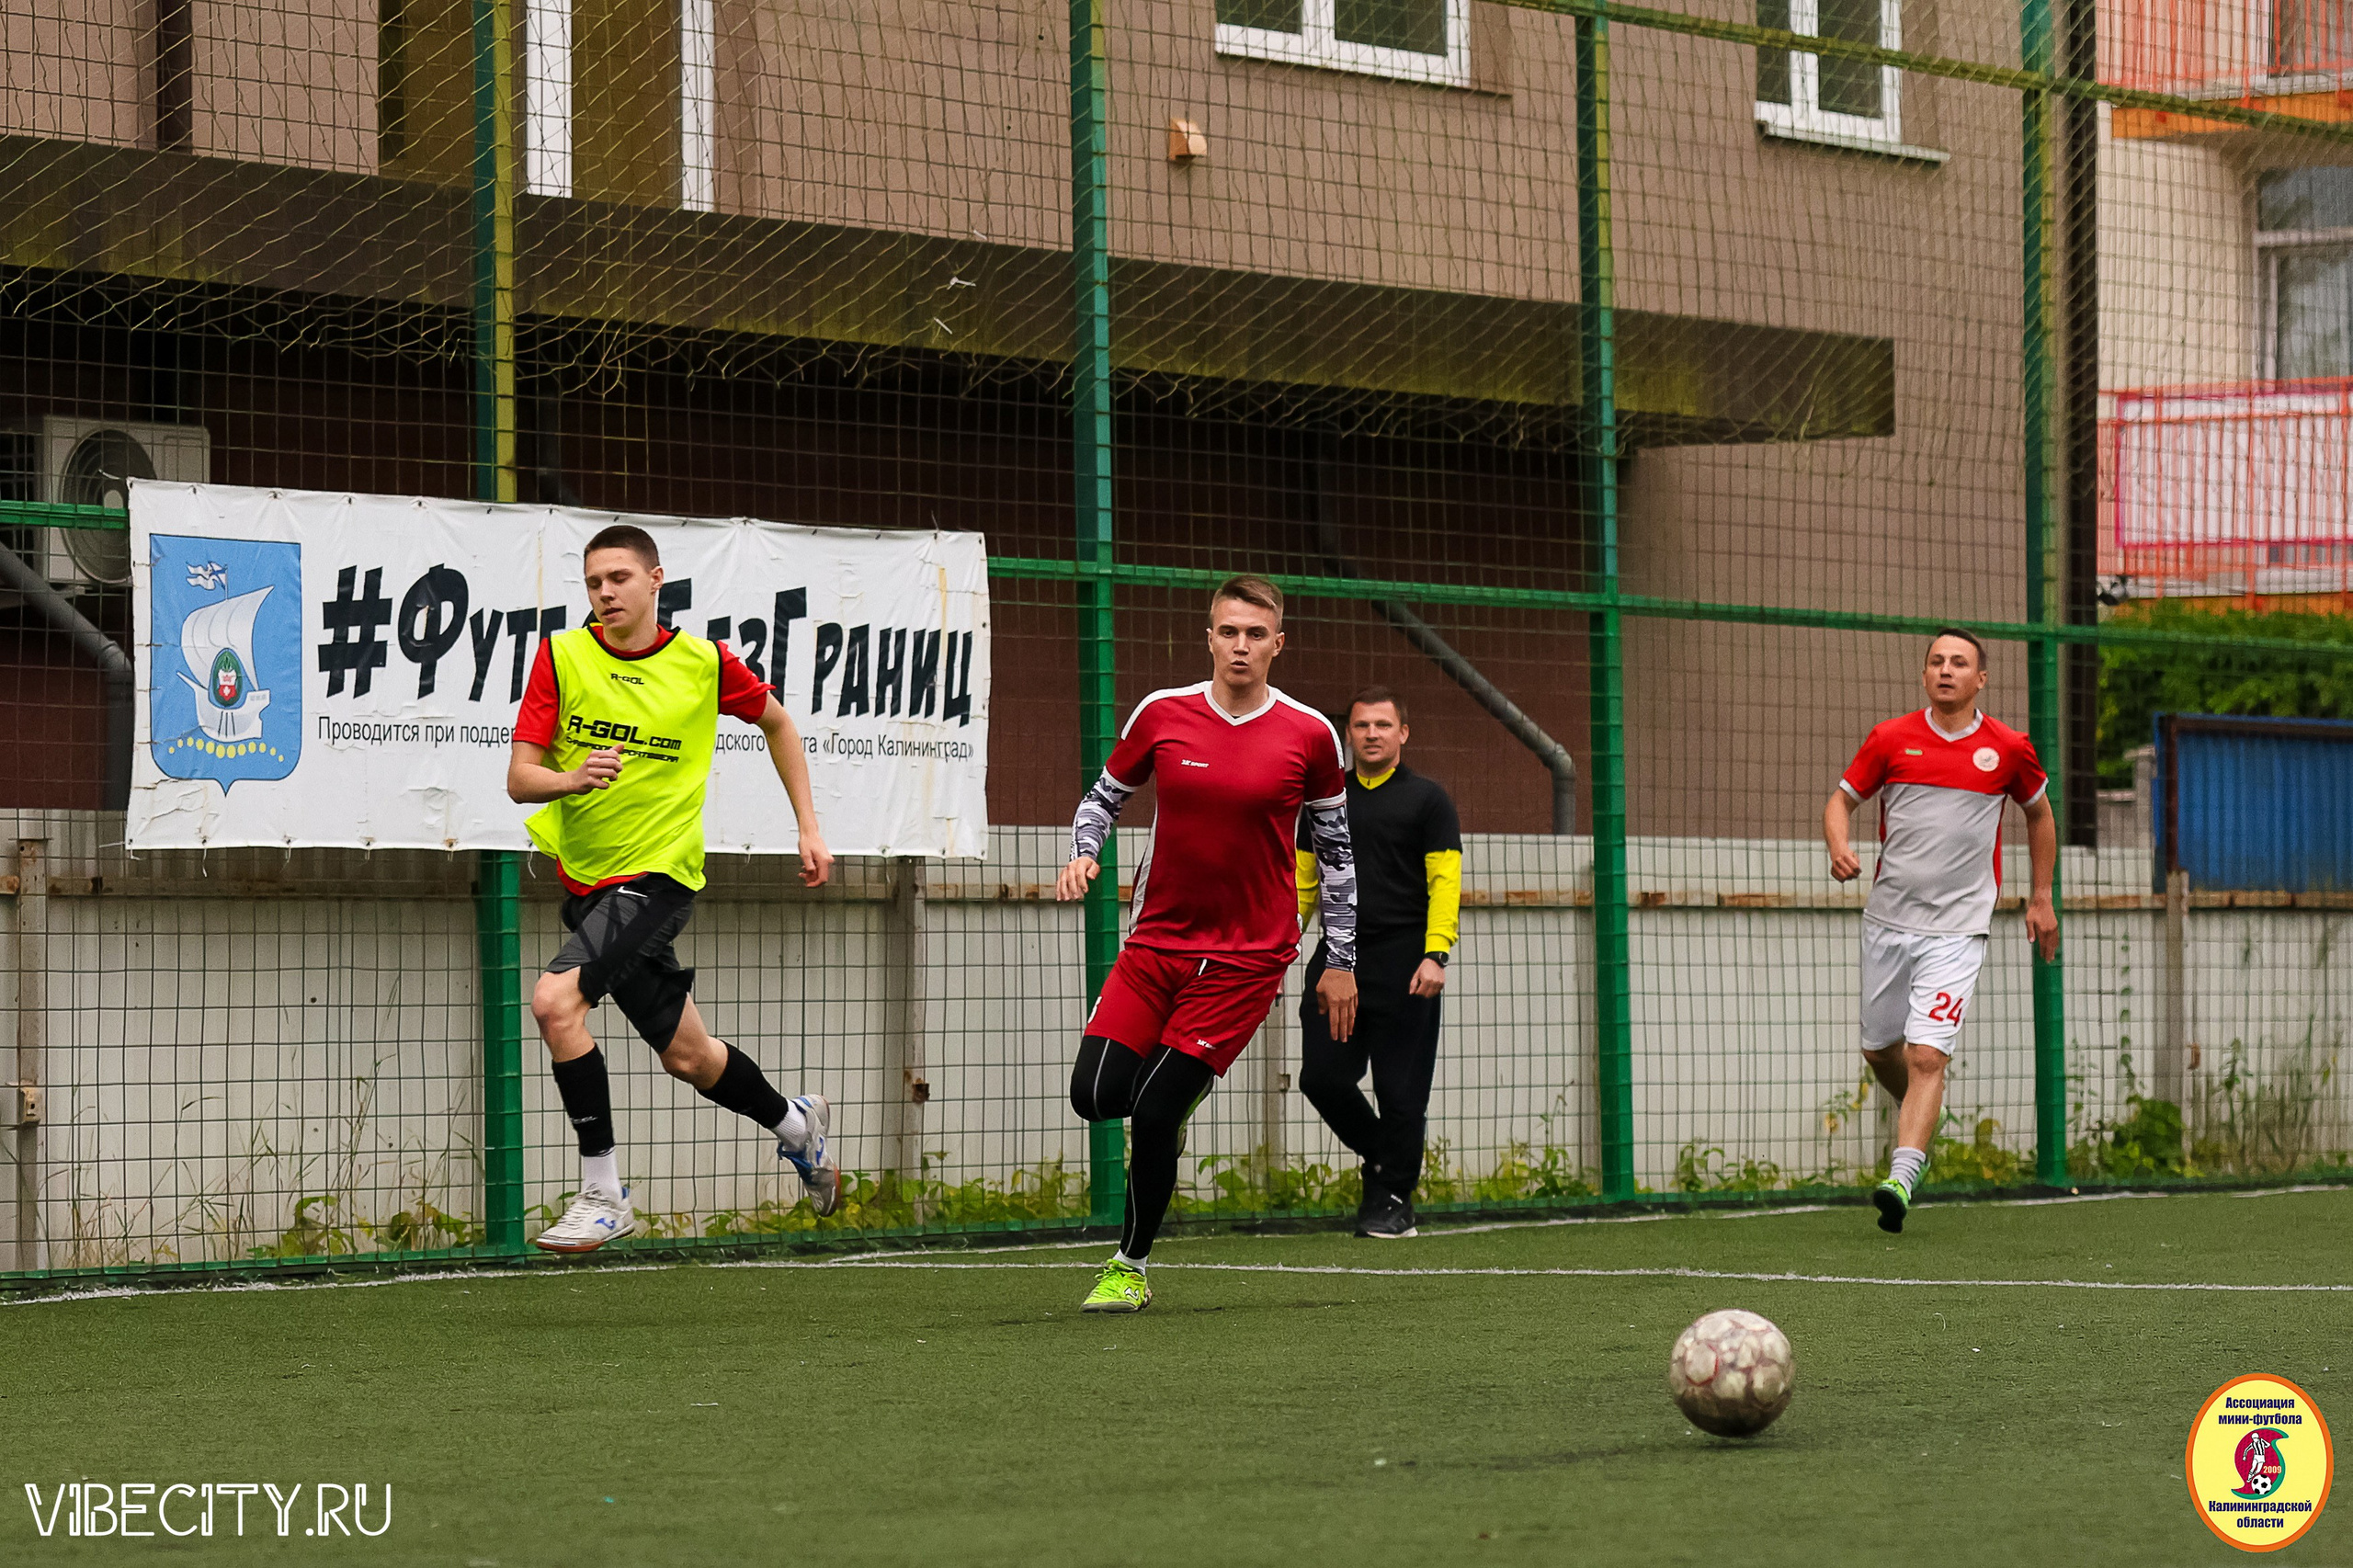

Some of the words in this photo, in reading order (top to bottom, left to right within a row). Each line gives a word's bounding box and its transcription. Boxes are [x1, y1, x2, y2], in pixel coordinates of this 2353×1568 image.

[318, 716, 419, 746] Проводится
[426, 724, 455, 747] при
[713, 733, 766, 755] дского
[823, 733, 873, 759] «Город
[879, 734, 974, 761] Калининград»
[1928, 992, 1963, 1027] 24
